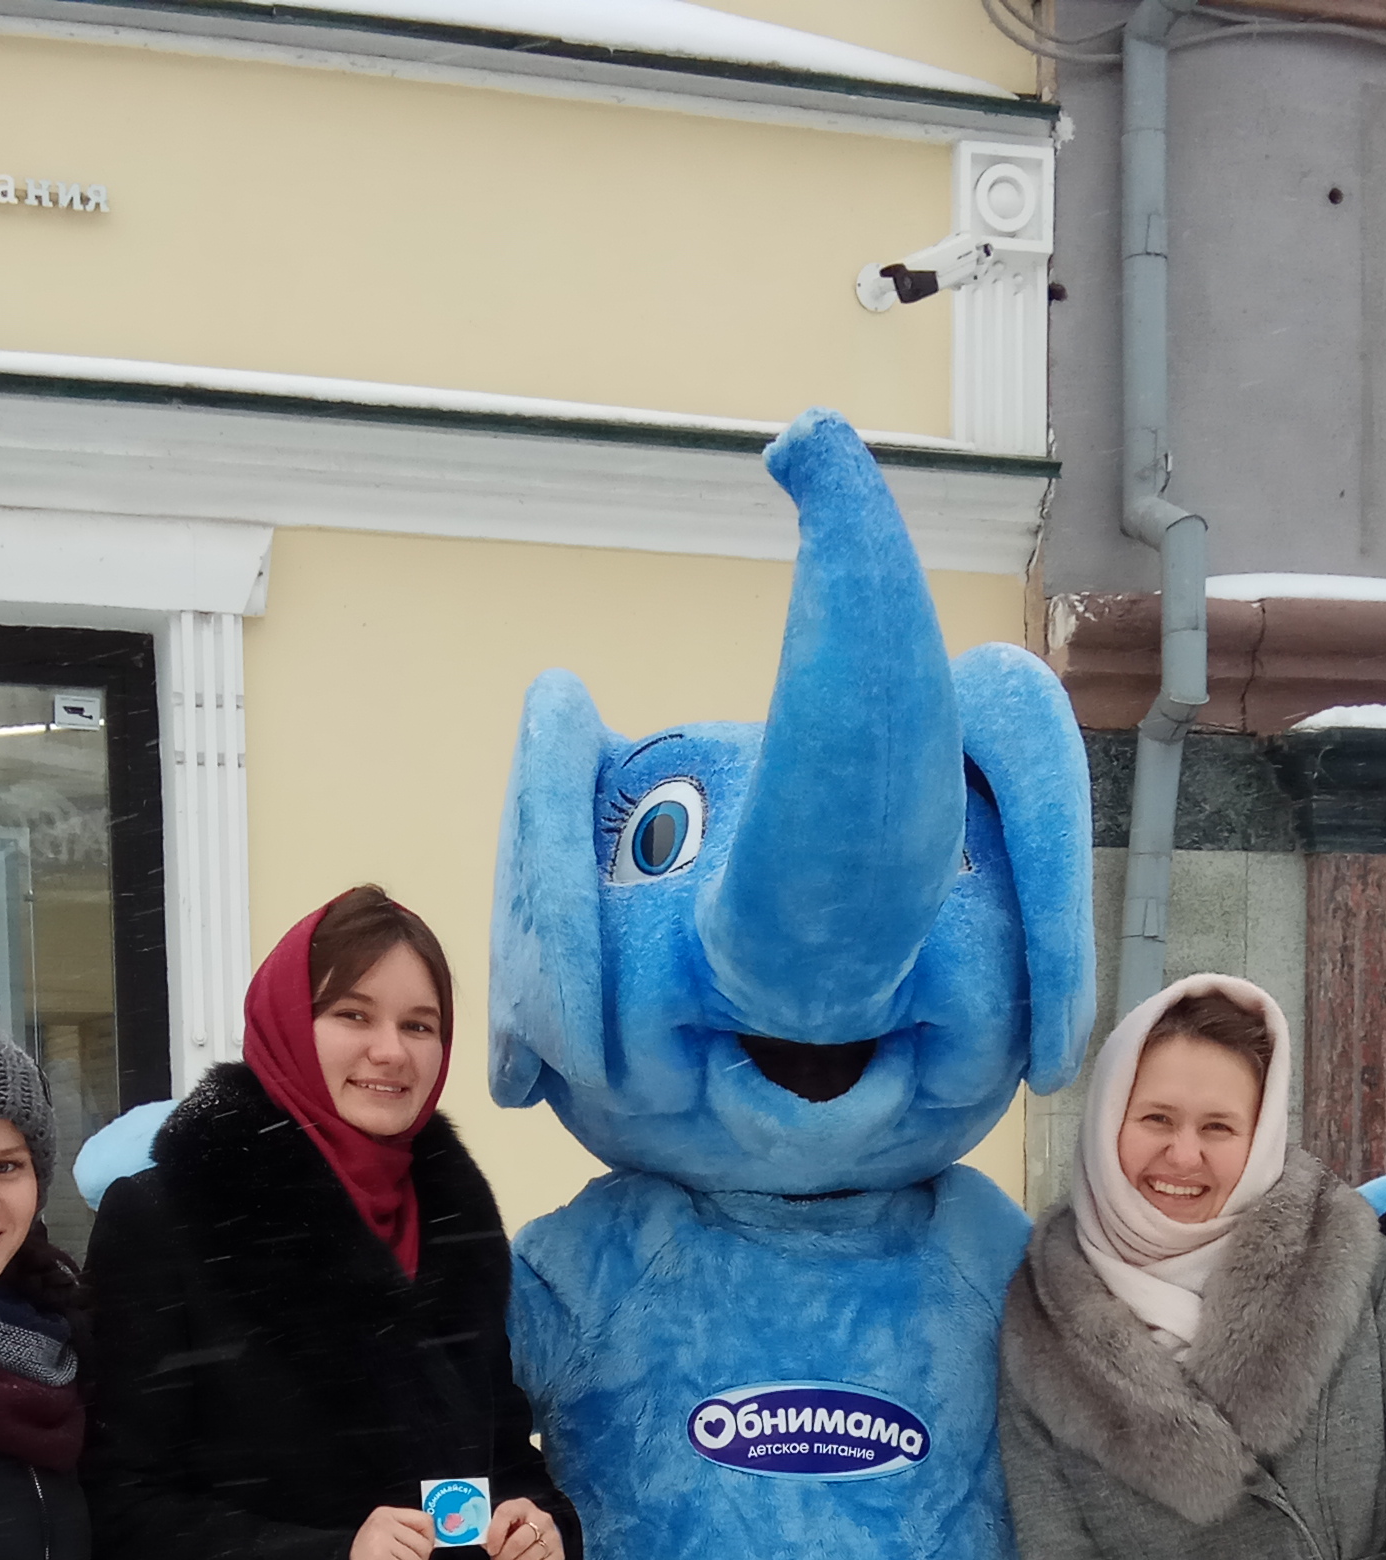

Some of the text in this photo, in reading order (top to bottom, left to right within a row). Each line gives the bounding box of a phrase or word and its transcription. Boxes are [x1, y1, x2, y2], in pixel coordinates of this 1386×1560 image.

[694, 1402, 924, 1456] Обнимама
[747, 1442, 875, 1461] детское питание
